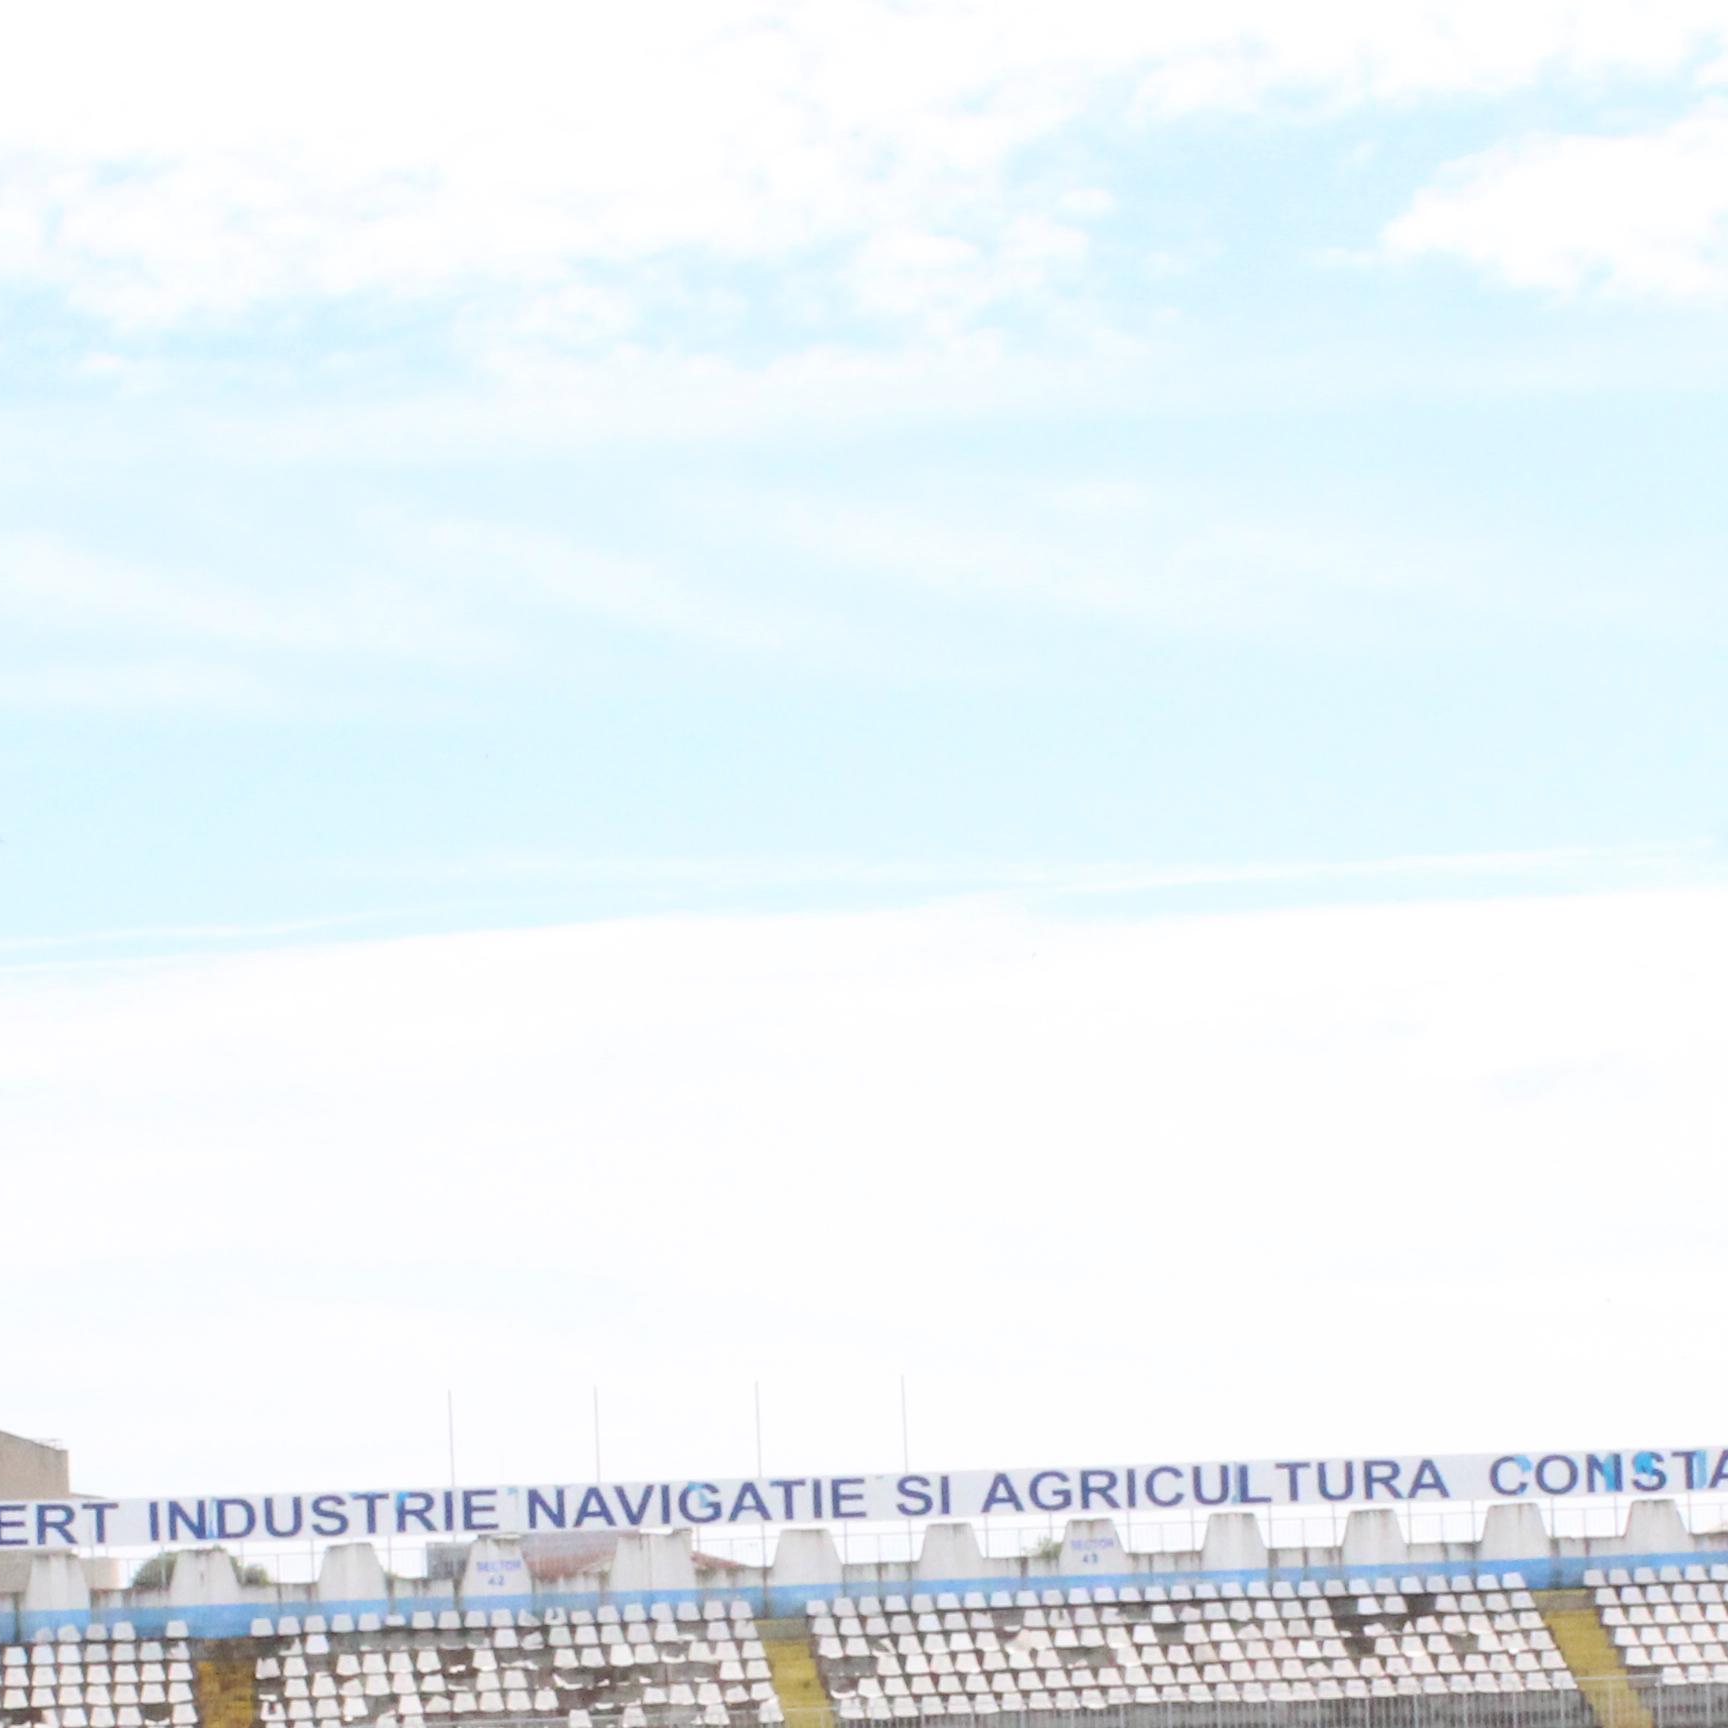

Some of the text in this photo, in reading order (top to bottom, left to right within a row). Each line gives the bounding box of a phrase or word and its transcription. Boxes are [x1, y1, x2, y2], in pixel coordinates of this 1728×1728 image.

[149, 1490, 500, 1542] INDUSTRIE
[527, 1477, 868, 1529] NAVIGATIE
[897, 1474, 951, 1517] SI
[980, 1459, 1451, 1514] AGRICULTURA
[1071, 1538, 1114, 1550] SECTOR
[476, 1560, 521, 1572] SECTOR
